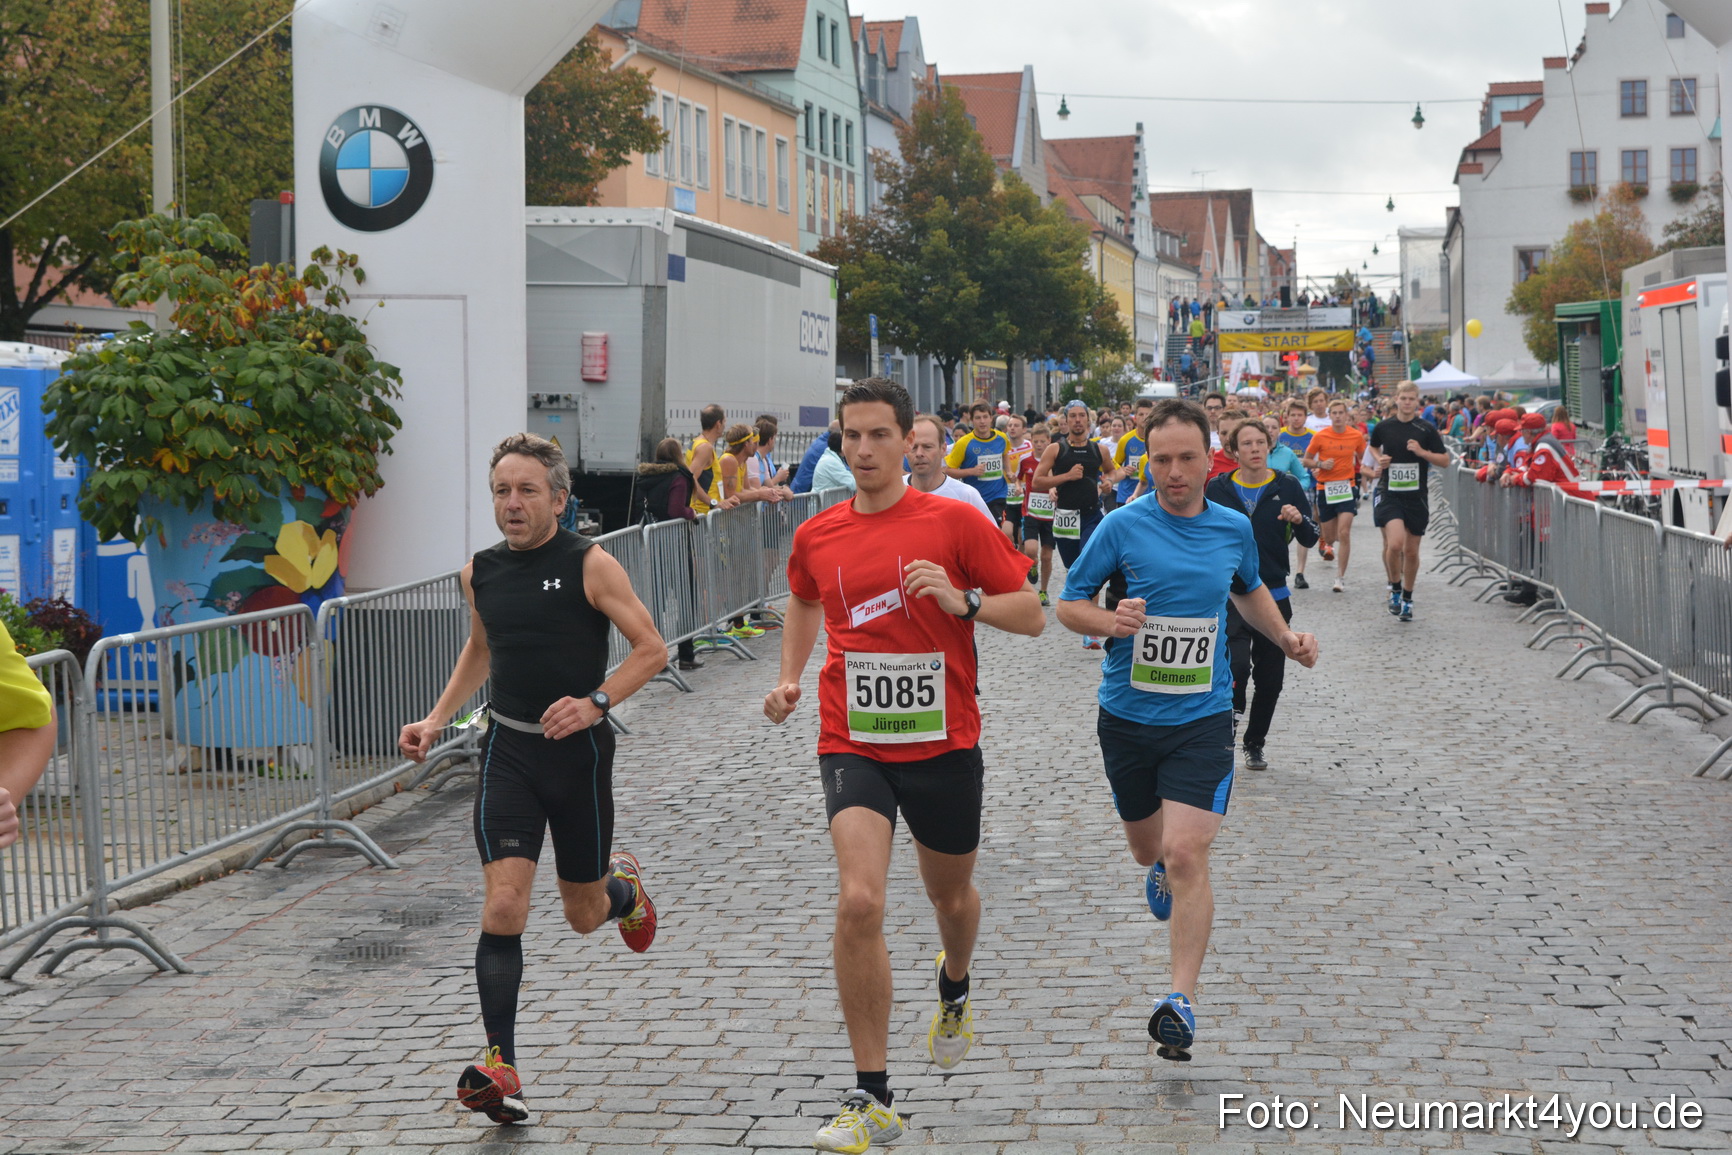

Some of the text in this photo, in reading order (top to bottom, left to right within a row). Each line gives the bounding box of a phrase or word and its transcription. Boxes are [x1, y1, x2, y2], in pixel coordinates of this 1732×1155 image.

[326, 107, 424, 150] BMW
[800, 310, 830, 356] BOCK
[1263, 335, 1310, 348] START
[981, 460, 1001, 471] 093
[1391, 469, 1417, 480] 5045
[1327, 484, 1350, 496] 5522
[1031, 499, 1053, 510] 5523
[864, 599, 887, 616] DEHN
[1142, 622, 1206, 633] ARTL Neumarkt
[1142, 634, 1210, 664] 5078
[847, 660, 927, 671] PARTL Neumarkt
[1150, 670, 1197, 683] Clemens
[856, 675, 936, 709] 5085
[872, 717, 917, 733] Jürgen
